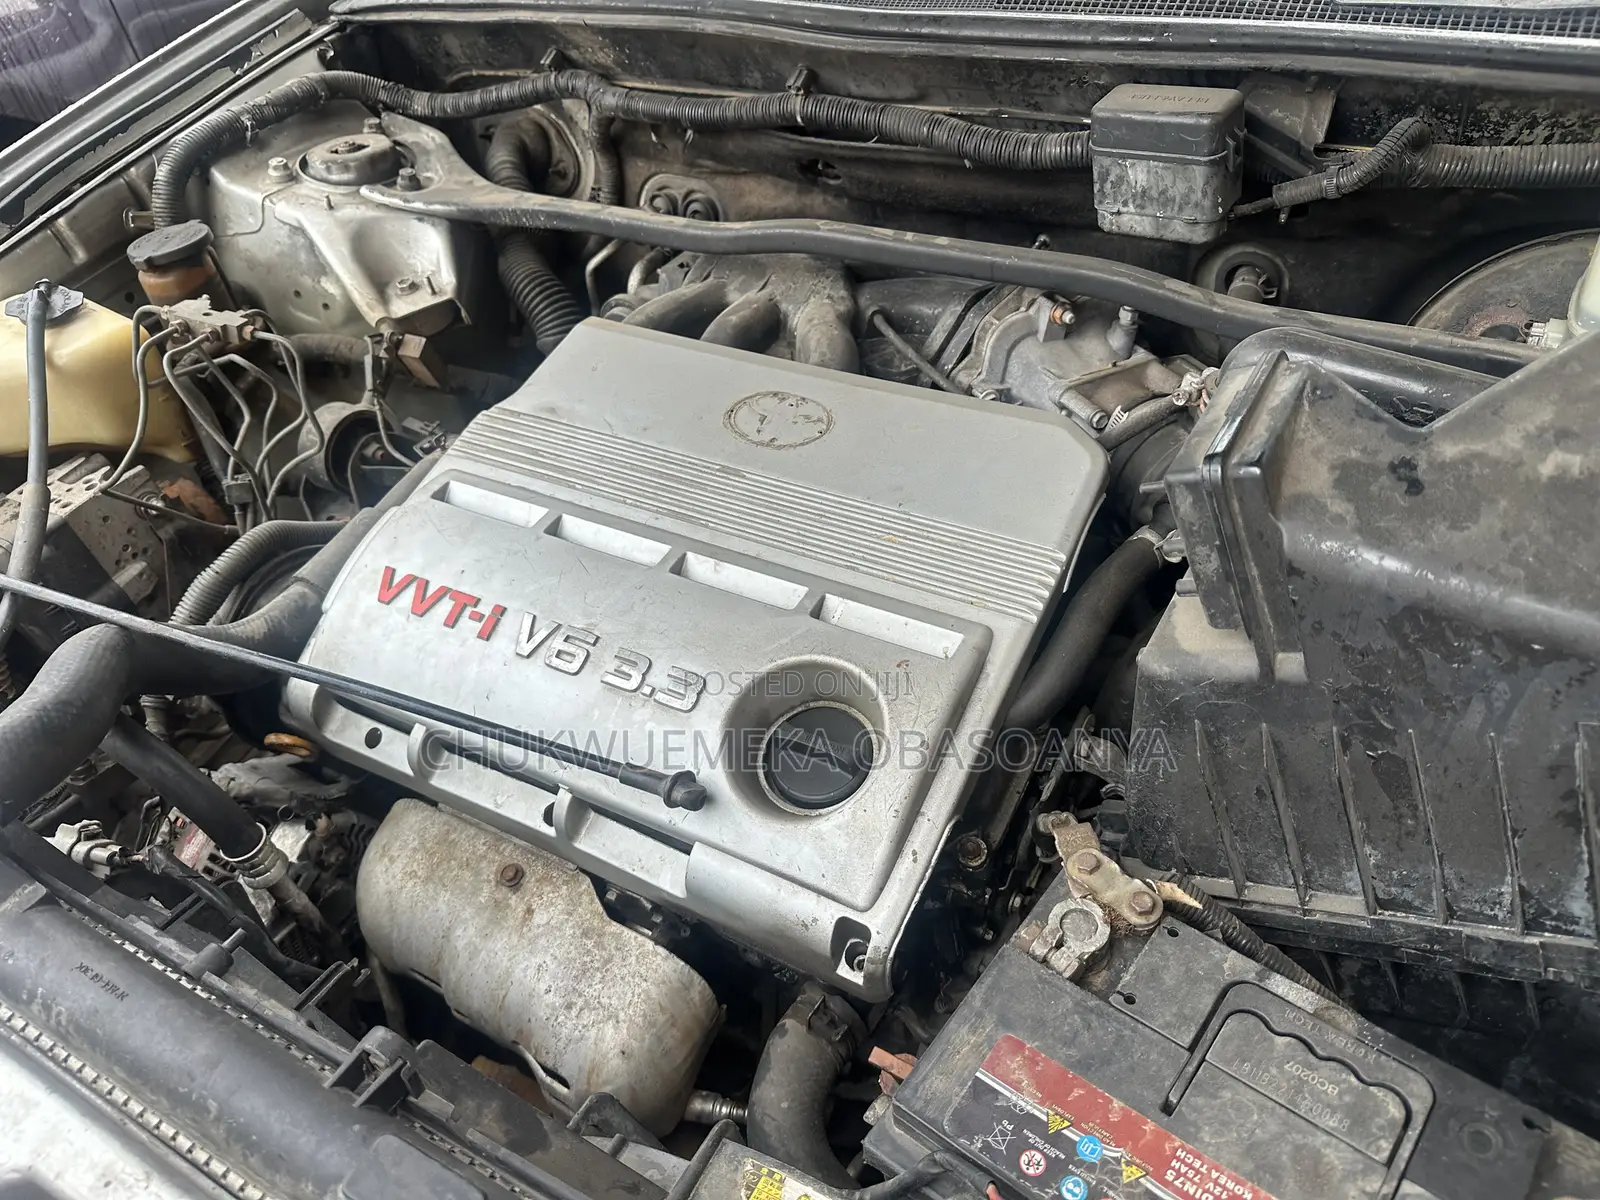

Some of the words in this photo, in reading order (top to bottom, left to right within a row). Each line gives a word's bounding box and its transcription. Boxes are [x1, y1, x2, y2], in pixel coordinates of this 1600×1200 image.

[377, 565, 506, 641] VVT-i
[515, 612, 600, 676] V6
[601, 646, 706, 713] 3.3
[1283, 1007, 1321, 1033] TECH
[1324, 1030, 1377, 1064] KOREA
[1283, 1058, 1340, 1096] BC0207
[1001, 1120, 1014, 1131] Pb
[1022, 1128, 1045, 1145] CHILDREN
[1043, 1147, 1056, 1157] KEEP
[1048, 1145, 1065, 1159] REACH
[1174, 1147, 1210, 1173] TECH
[1169, 1157, 1203, 1183] 75AH
[1163, 1167, 1214, 1200] DIN75
[1204, 1180, 1230, 1200] 12V
[1208, 1168, 1254, 1200] KOREA
